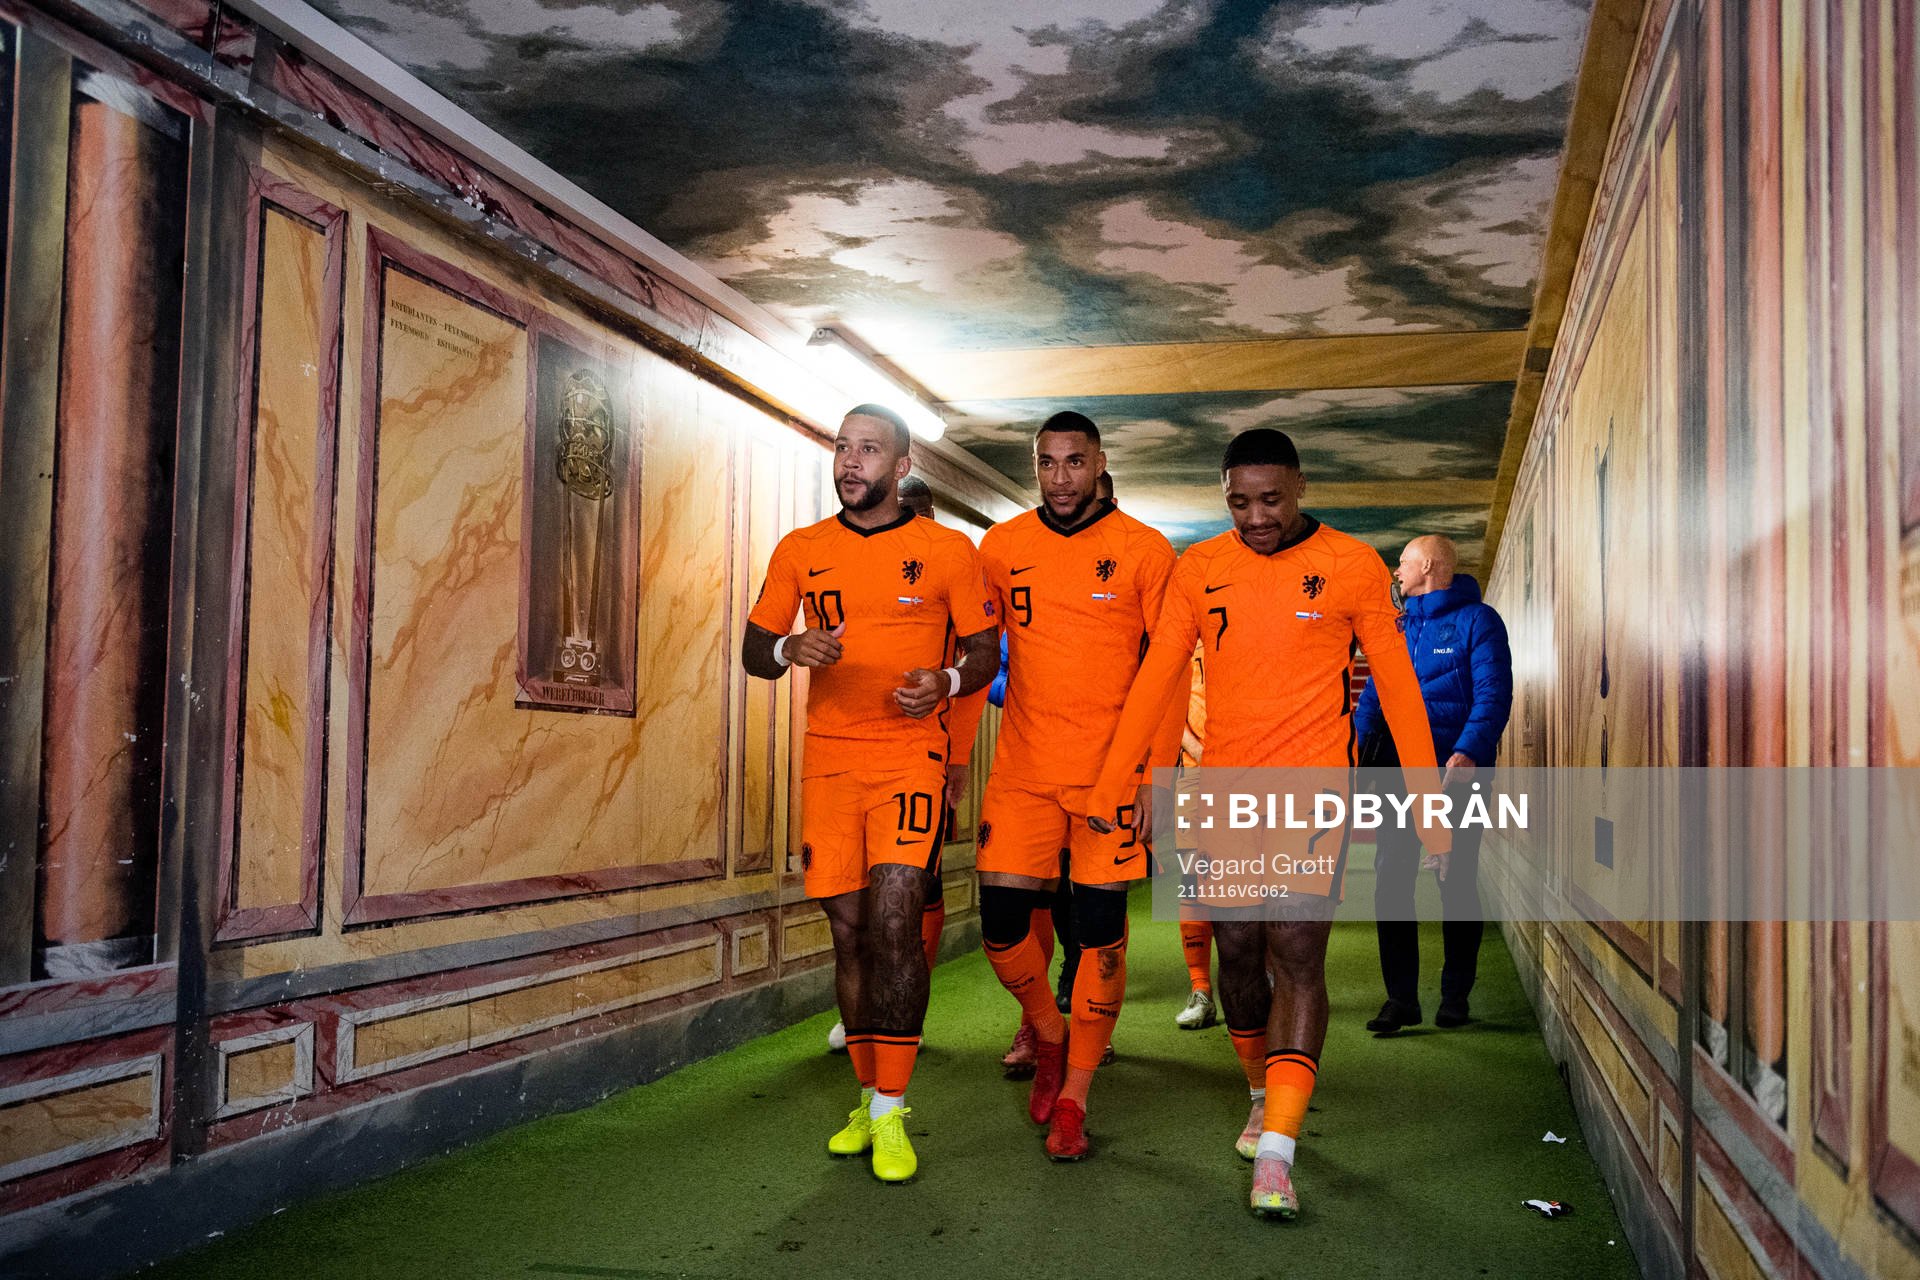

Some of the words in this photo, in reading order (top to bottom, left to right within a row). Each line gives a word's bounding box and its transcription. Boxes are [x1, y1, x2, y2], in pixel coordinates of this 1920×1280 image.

[806, 590, 845, 631] 10
[1011, 586, 1032, 627] 9
[1208, 607, 1228, 651] 7
[893, 792, 932, 834] 10
